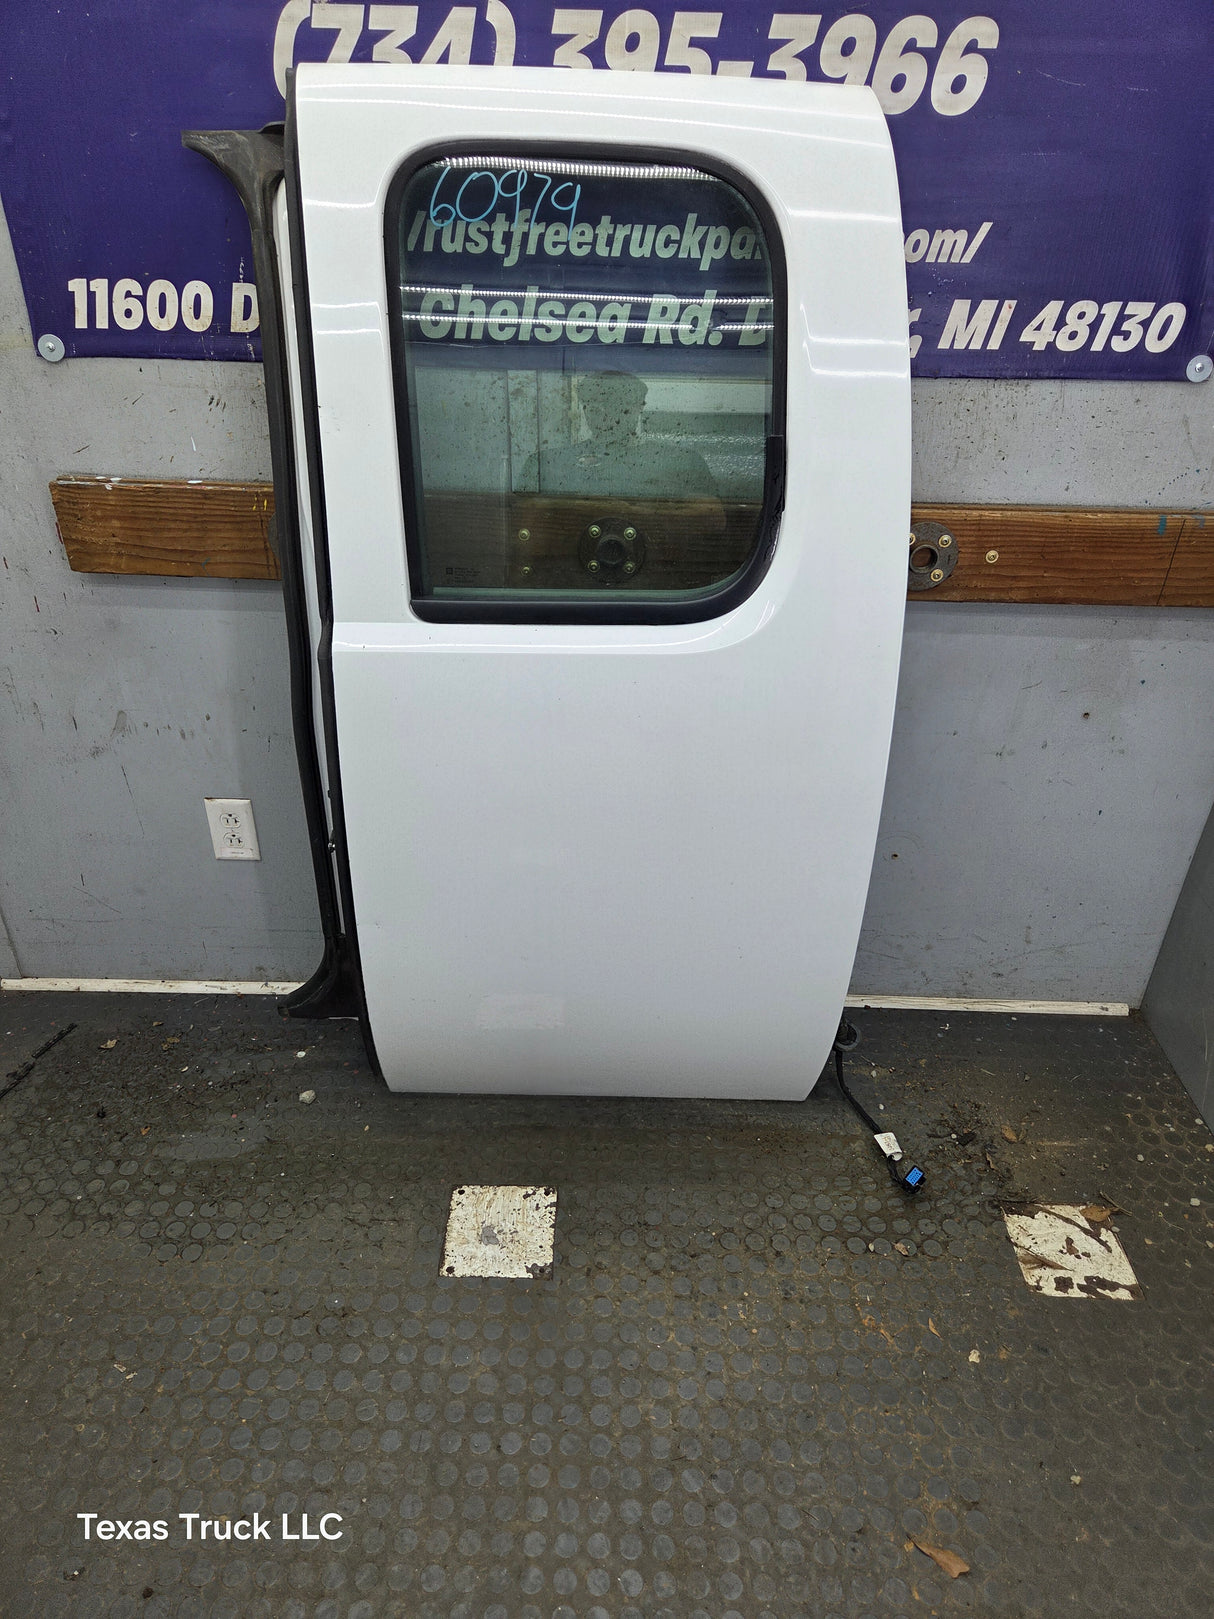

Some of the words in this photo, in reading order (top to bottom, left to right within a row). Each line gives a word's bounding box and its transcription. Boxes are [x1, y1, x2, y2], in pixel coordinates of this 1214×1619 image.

[551, 9, 999, 116] 395-3966
[407, 208, 764, 271] /rustfreetruckpa
[904, 221, 994, 264] om/
[429, 166, 581, 241] 60979
[67, 278, 214, 331] 11600
[419, 283, 636, 343] Chelsea
[642, 289, 725, 345] Rd.
[937, 299, 1018, 350] MI
[1019, 300, 1187, 353] 48130
